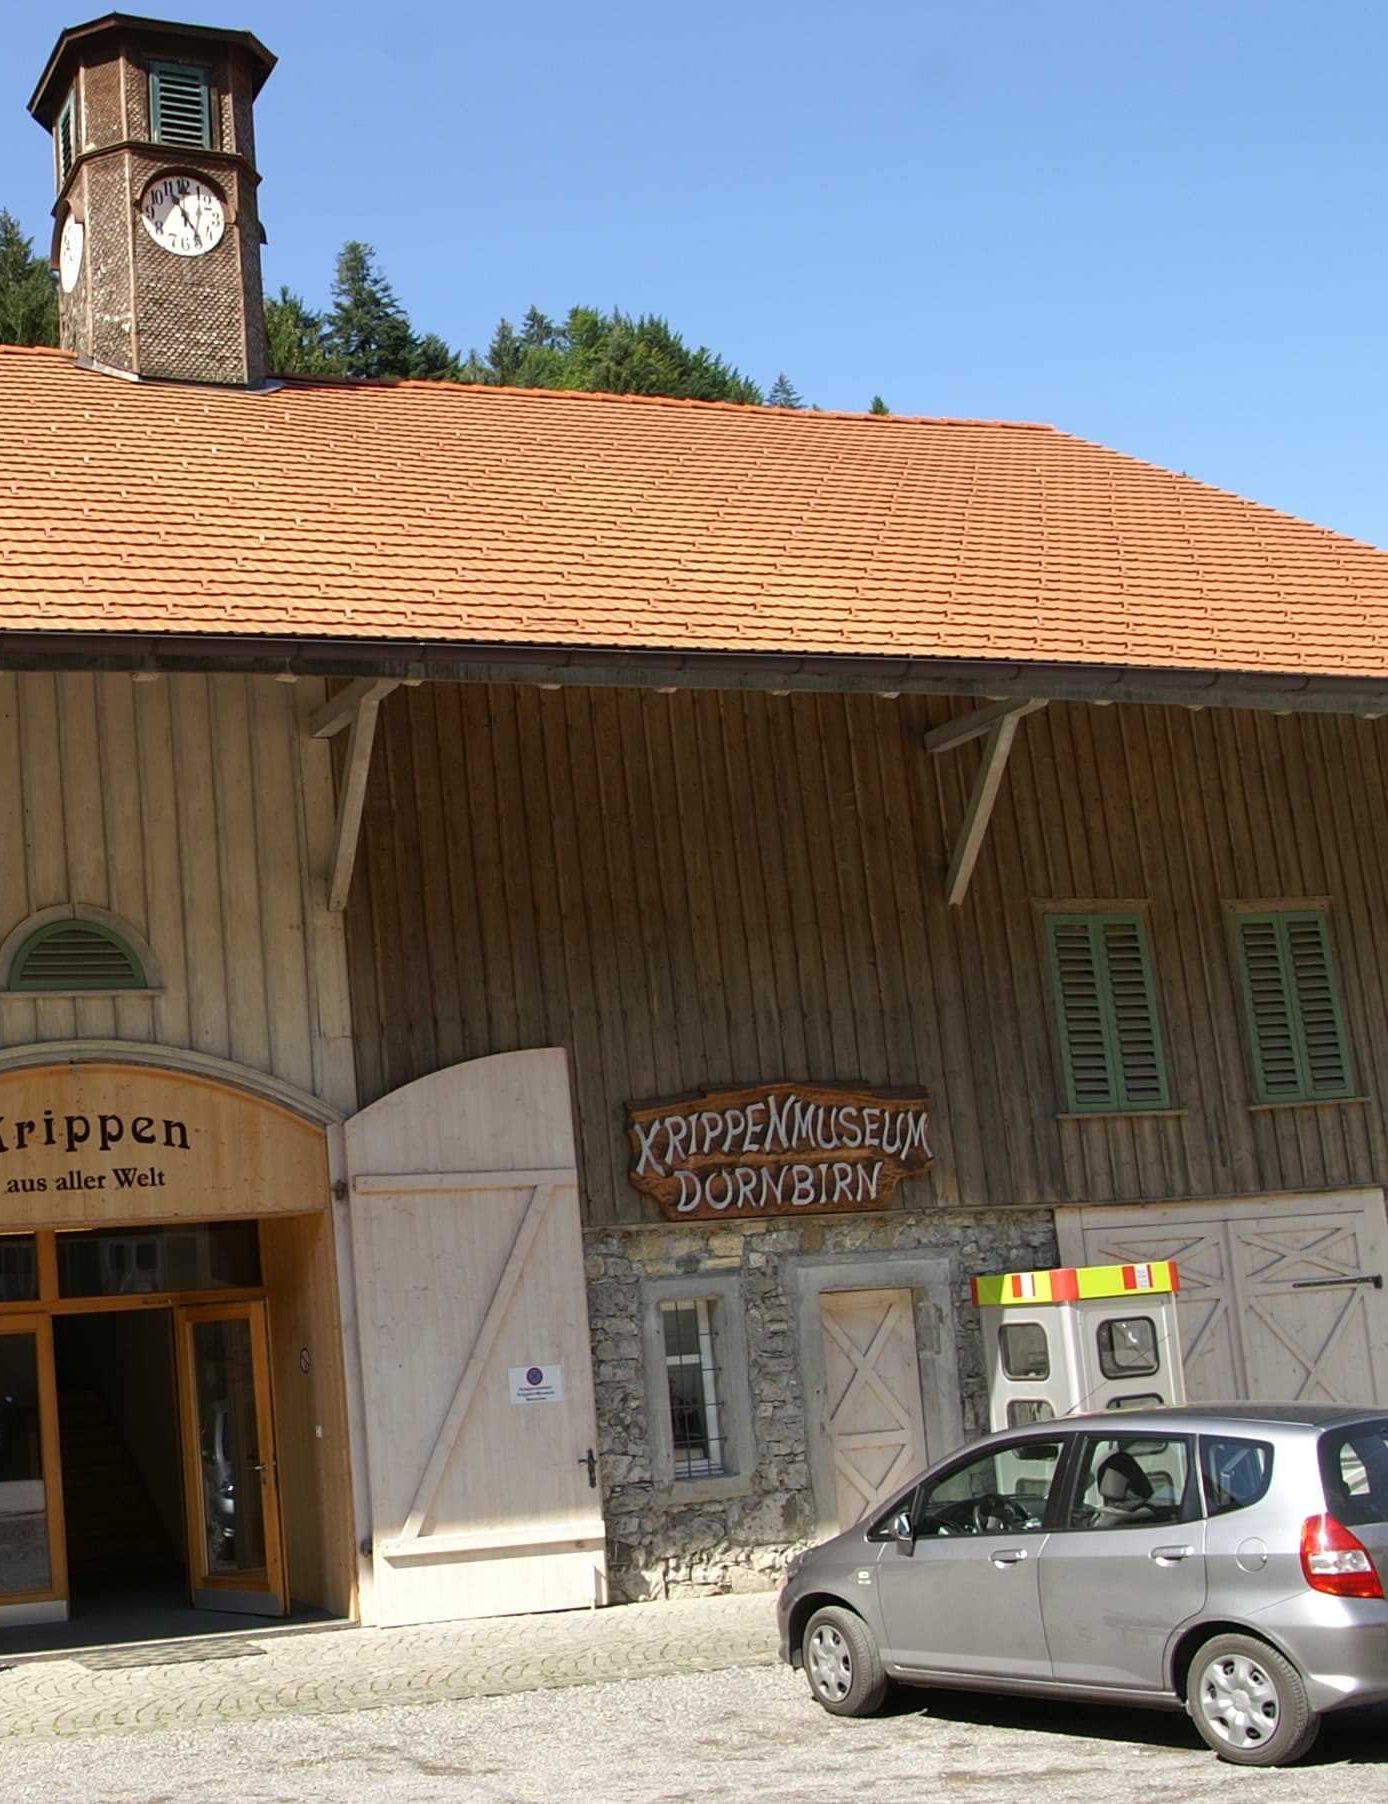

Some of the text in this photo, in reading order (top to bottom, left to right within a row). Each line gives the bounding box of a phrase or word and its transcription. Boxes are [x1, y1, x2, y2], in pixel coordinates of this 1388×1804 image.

[151, 188, 164, 206] 10
[203, 195, 212, 211] 2
[145, 204, 155, 220] 9
[212, 212, 220, 227] 3
[155, 221, 164, 235] 8
[168, 232, 177, 248] 7
[181, 236, 190, 252] 6
[633, 1094, 934, 1177] KRIPPENMUSEUM
[6, 1167, 166, 1193] aus aller Welt
[673, 1162, 884, 1212] DORNBIRN
